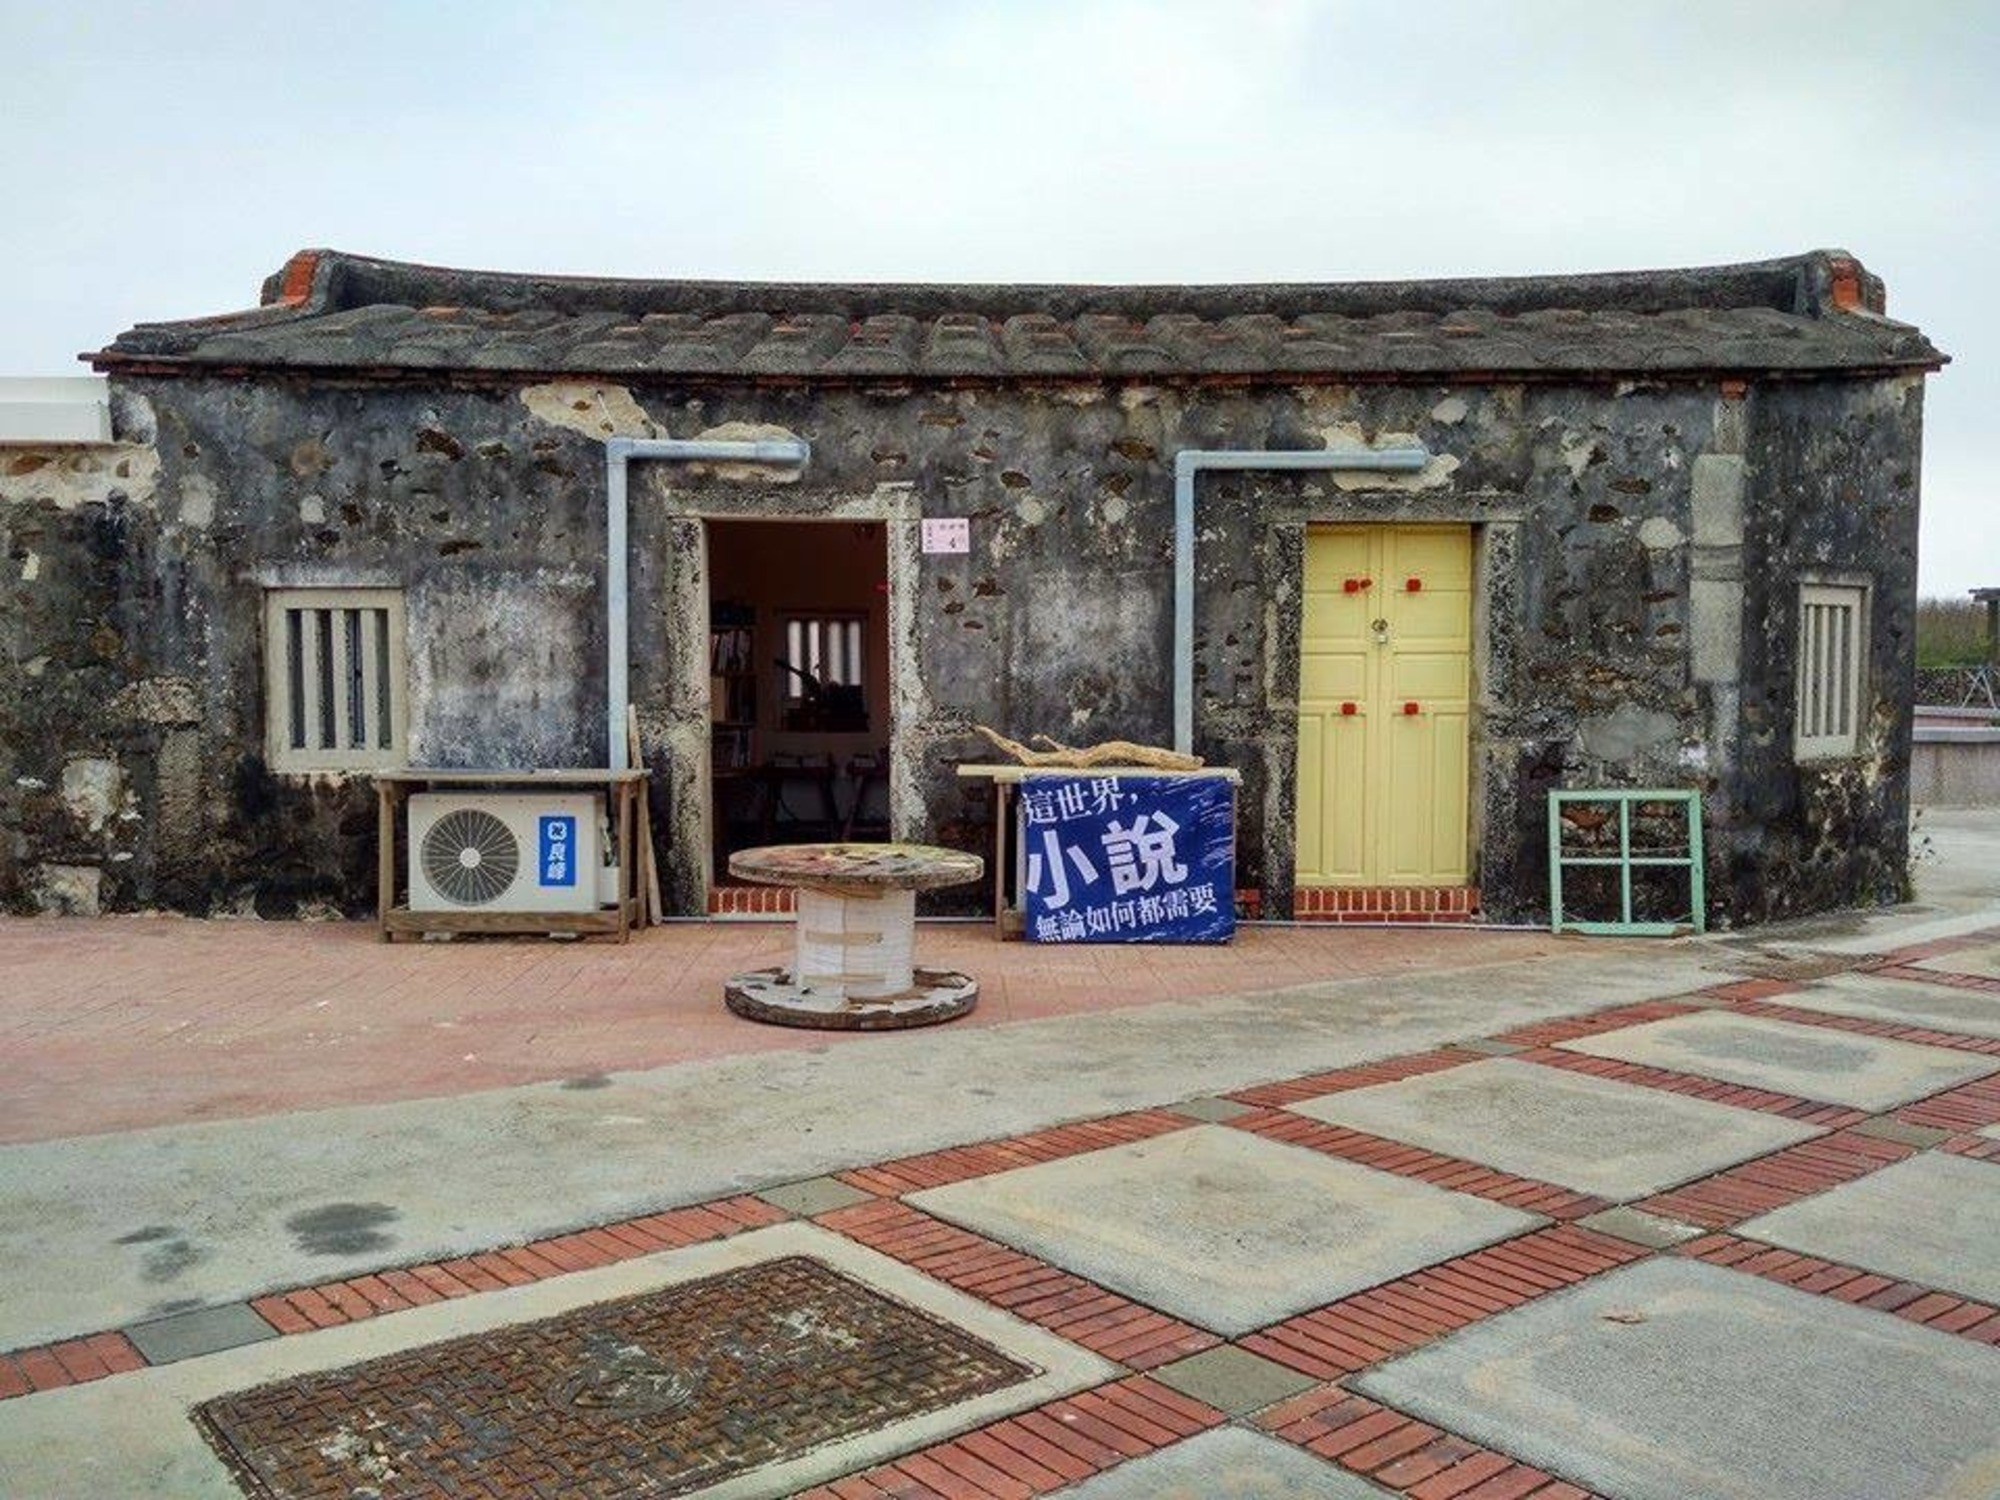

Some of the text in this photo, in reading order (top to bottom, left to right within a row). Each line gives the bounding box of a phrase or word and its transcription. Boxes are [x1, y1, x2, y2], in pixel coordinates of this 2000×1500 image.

[1026, 810, 1188, 909] 小說
[1035, 882, 1218, 942] 無論如何都需要
